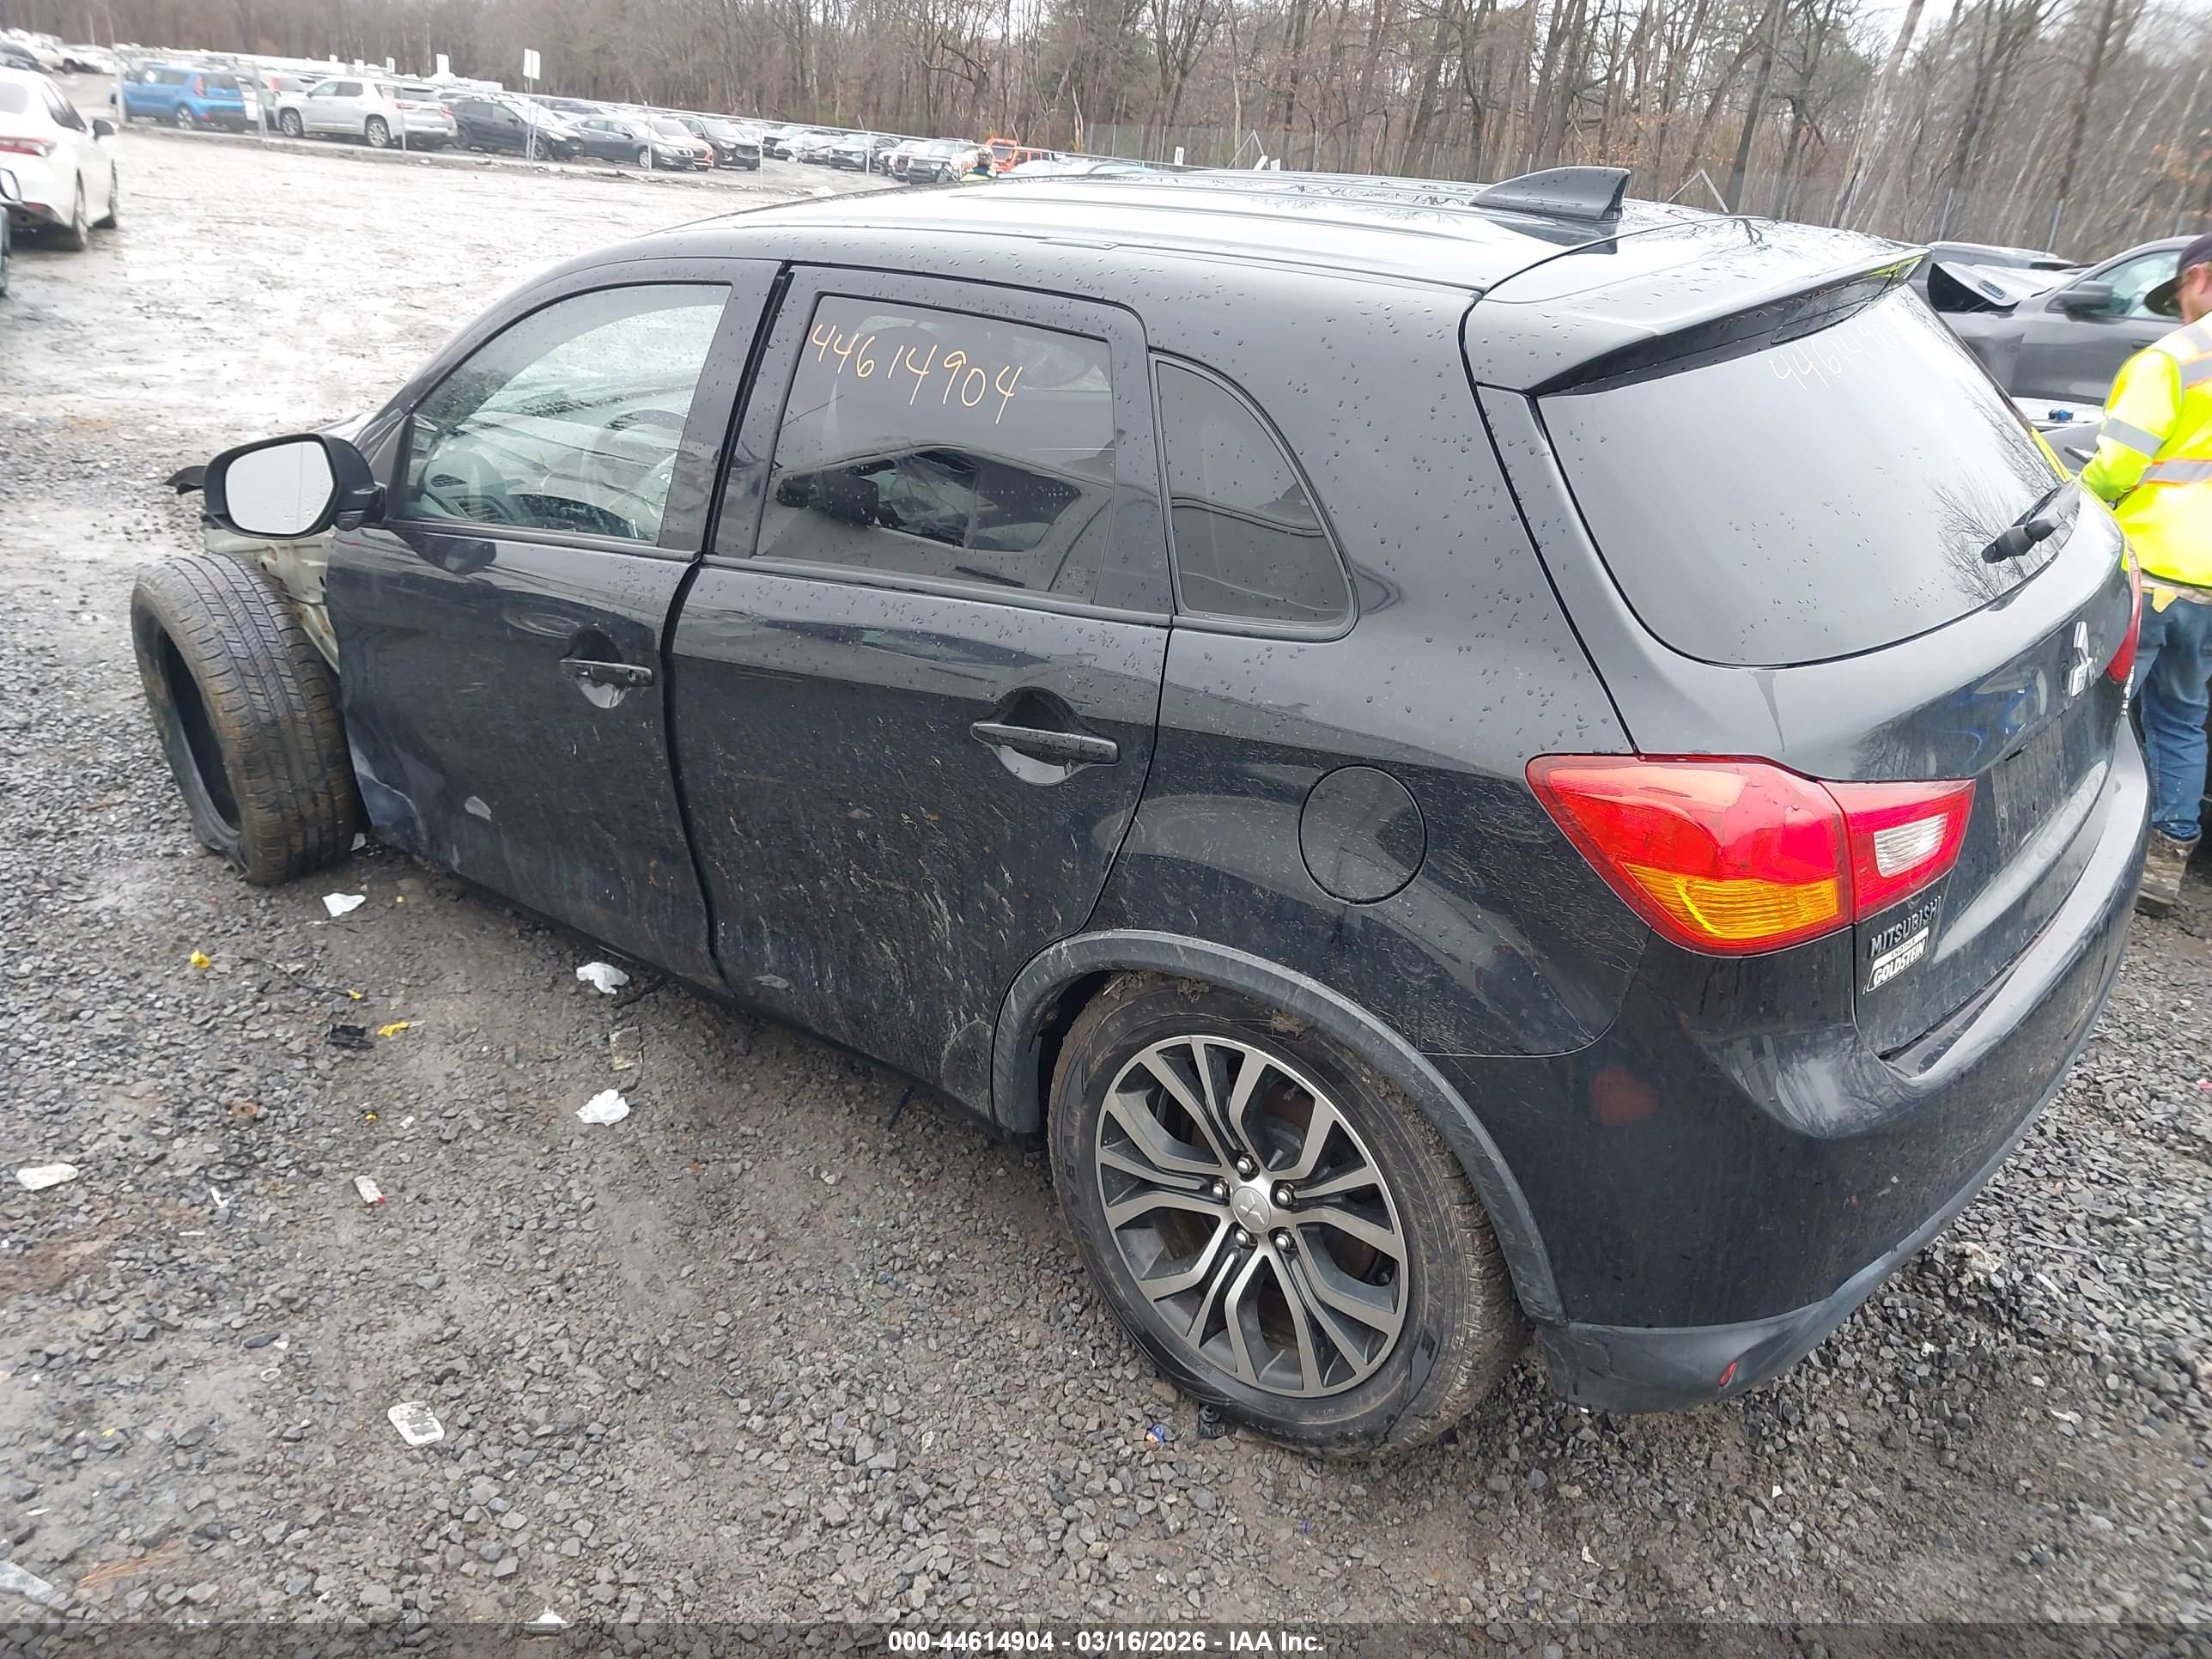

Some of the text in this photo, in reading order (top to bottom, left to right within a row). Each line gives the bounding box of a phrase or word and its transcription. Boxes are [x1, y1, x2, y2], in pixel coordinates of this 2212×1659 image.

[811, 324, 1024, 424] 44614904
[1870, 896, 1942, 957] MITSUBISHI
[1873, 939, 1926, 987] GOLDSTEIN
